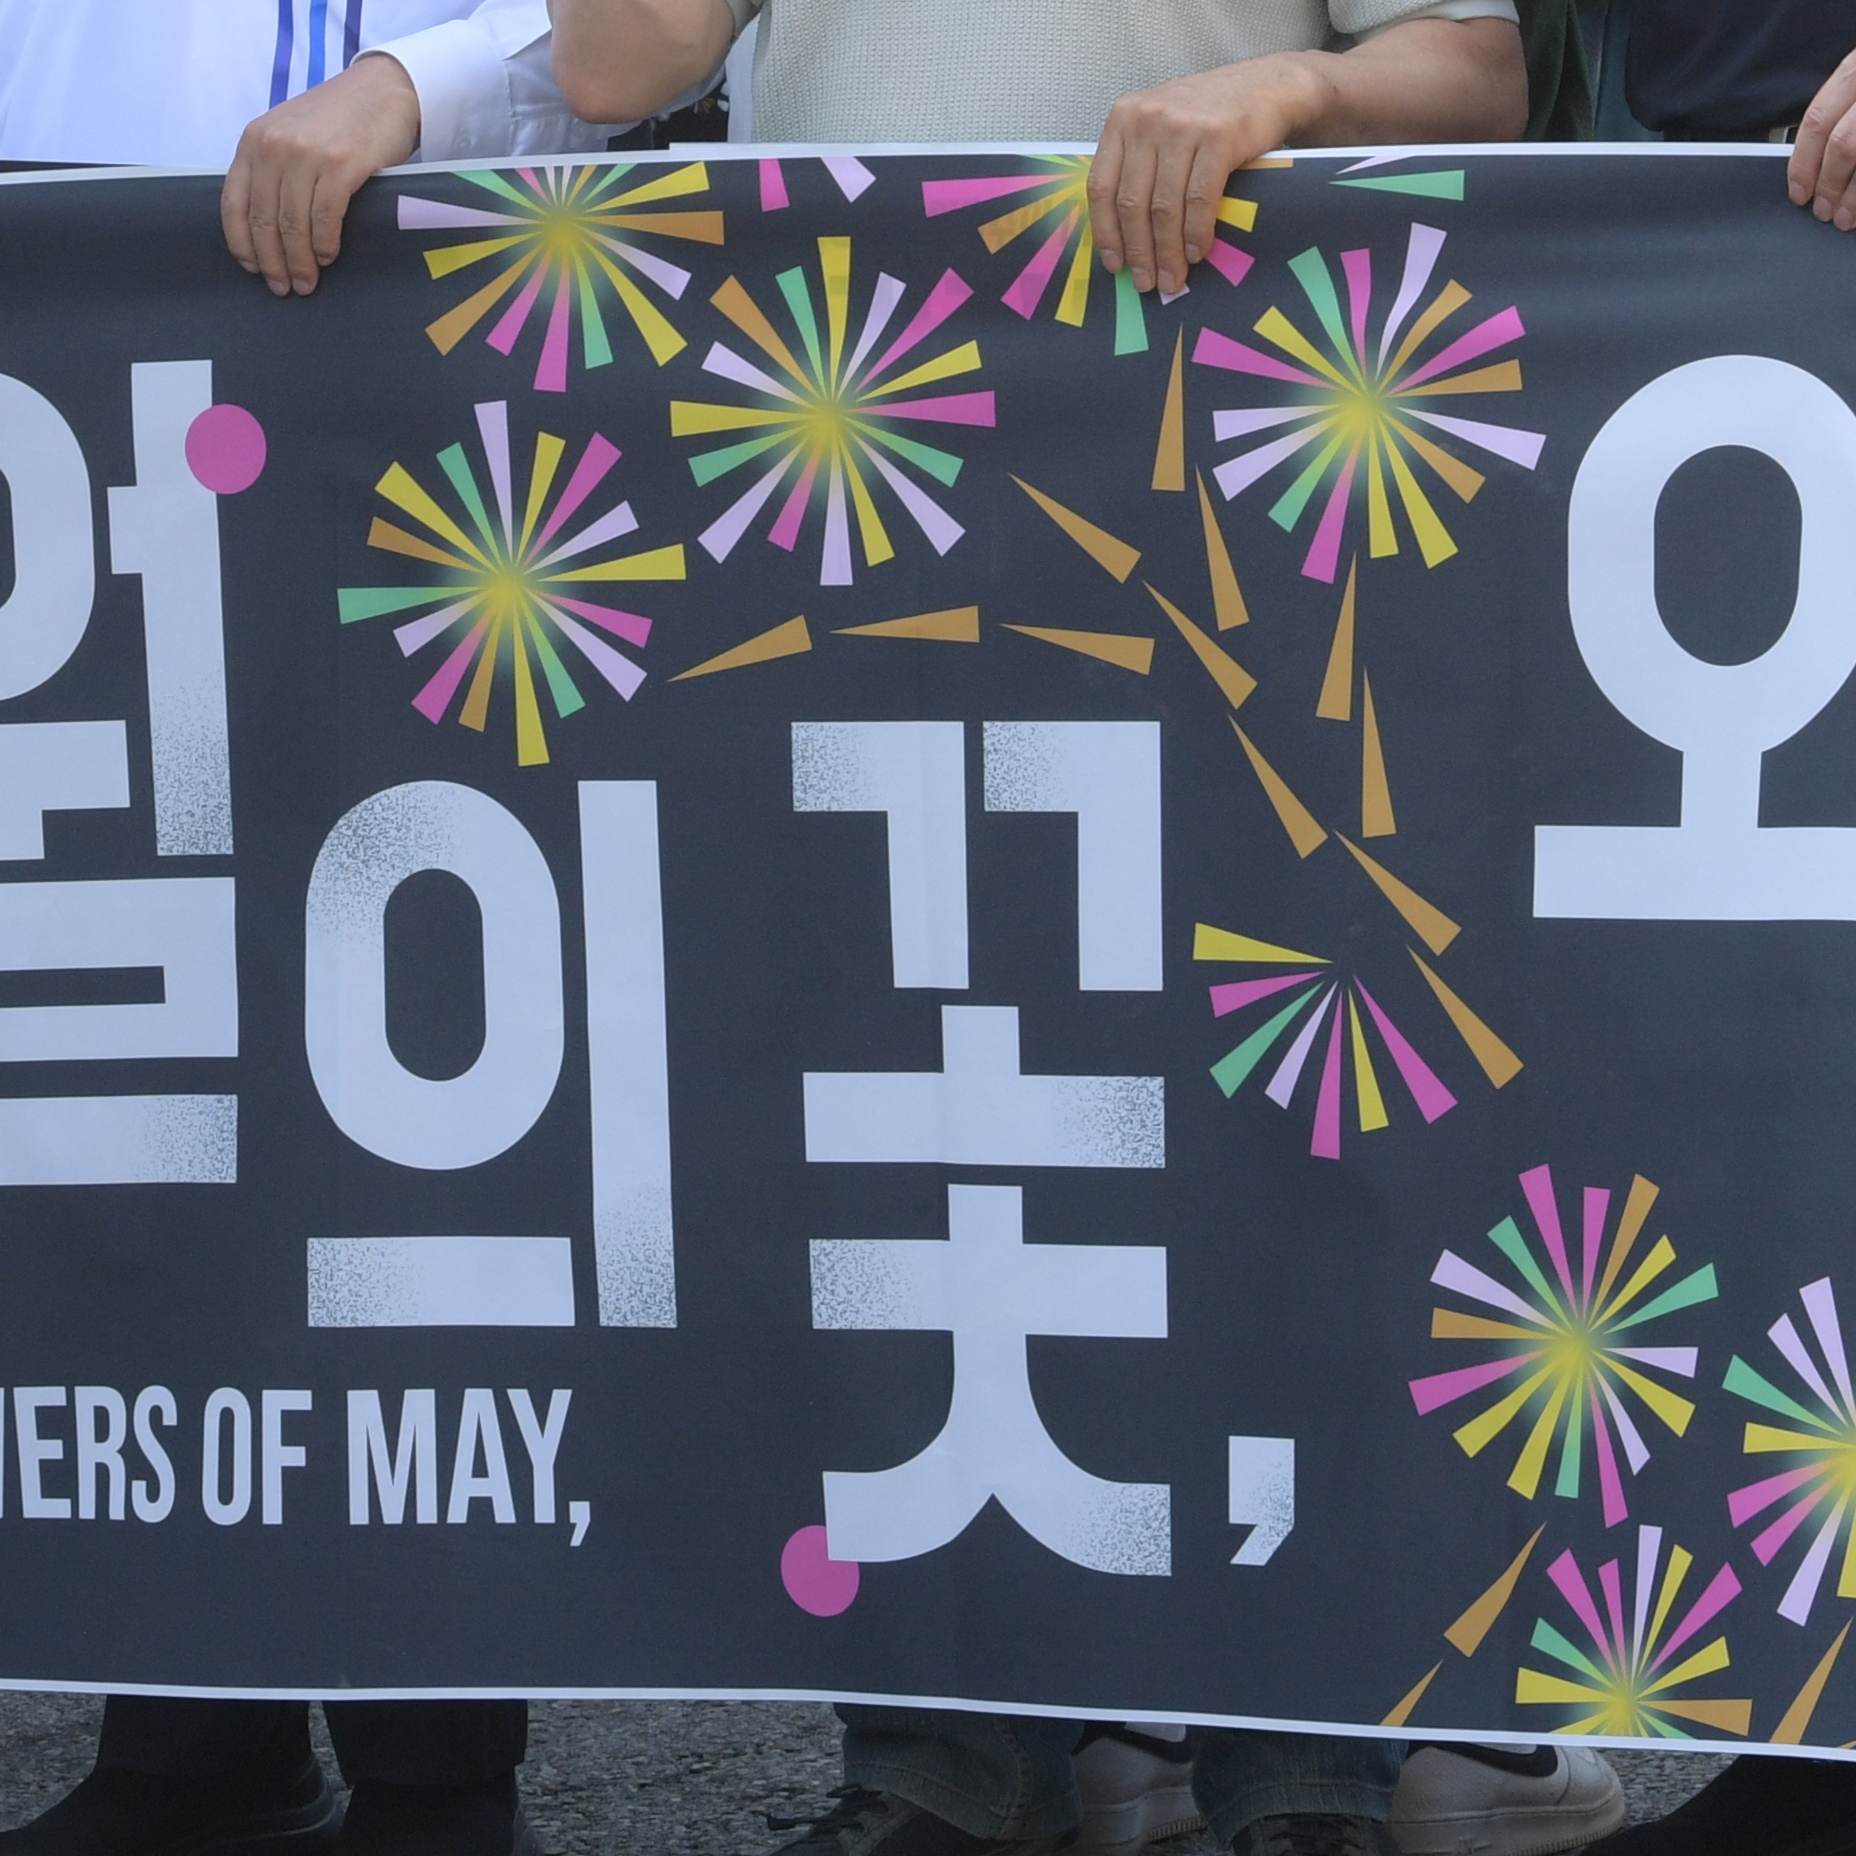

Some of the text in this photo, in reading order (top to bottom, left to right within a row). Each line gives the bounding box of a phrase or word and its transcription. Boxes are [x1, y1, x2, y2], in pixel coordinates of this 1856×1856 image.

[790, 720, 1297, 1578] 꽃,
[200, 1387, 315, 1527] OF
[344, 1387, 595, 1547] MAY,
